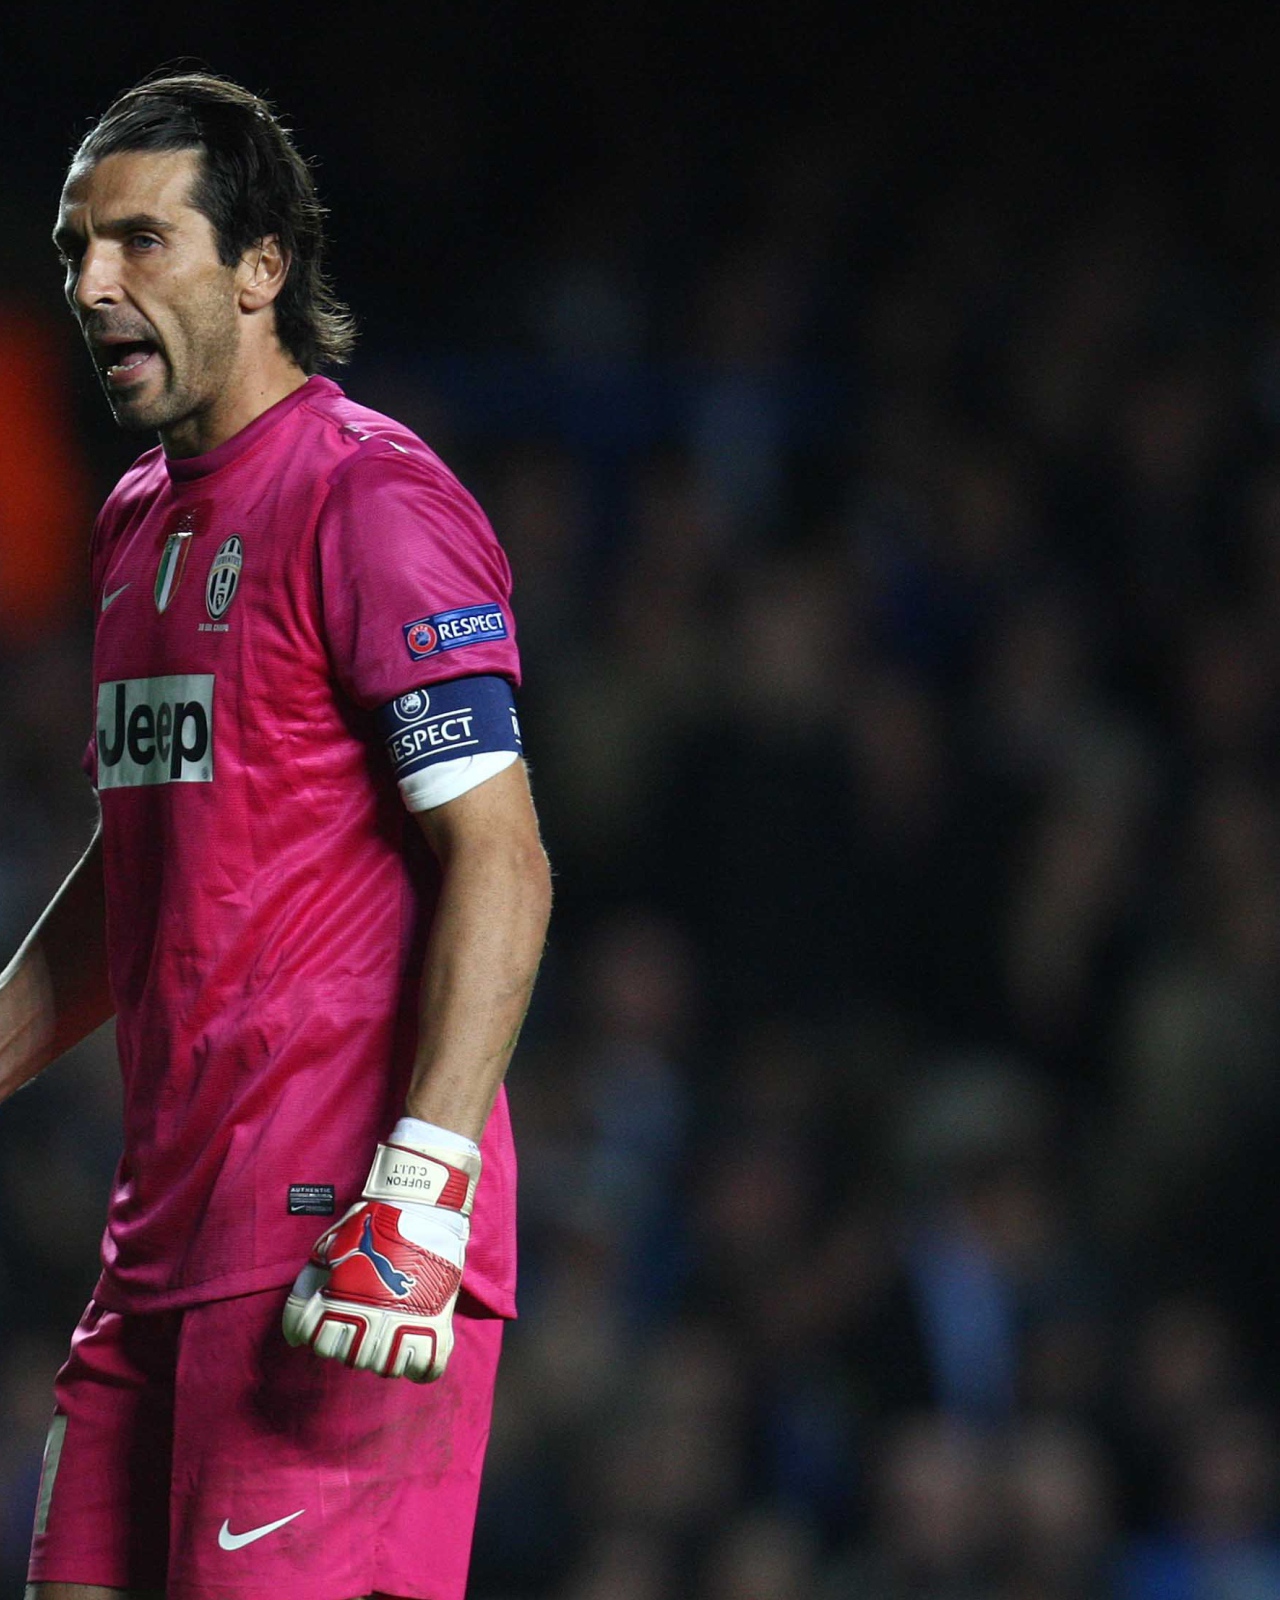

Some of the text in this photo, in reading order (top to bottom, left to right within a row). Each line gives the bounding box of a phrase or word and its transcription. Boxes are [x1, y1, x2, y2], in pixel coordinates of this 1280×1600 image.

[438, 613, 503, 640] RESPECT
[99, 683, 208, 779] Jeep
[386, 1176, 431, 1189] BUFFON
